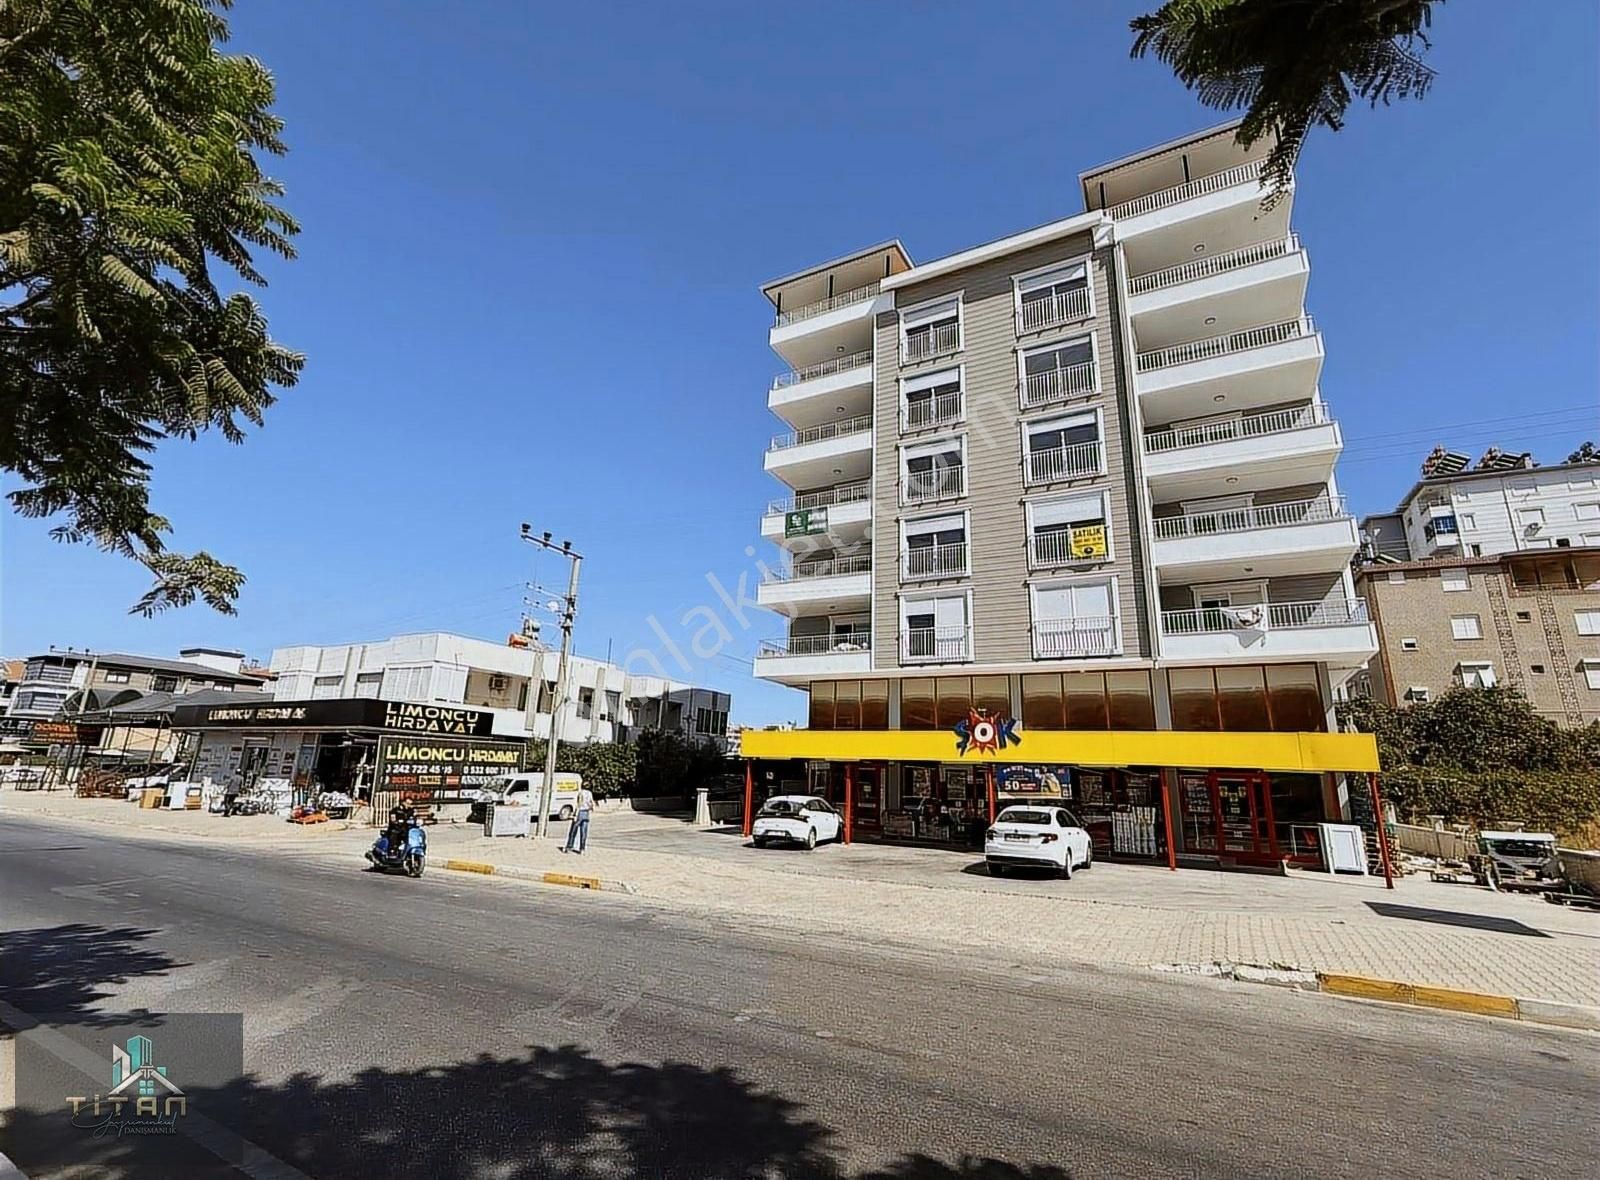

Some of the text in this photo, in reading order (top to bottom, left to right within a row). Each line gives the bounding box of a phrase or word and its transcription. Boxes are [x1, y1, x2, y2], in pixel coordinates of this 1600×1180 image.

[386, 702, 479, 722] LIMONCU
[385, 714, 477, 734] HIRDAVAT
[386, 743, 465, 761] LİMONCU
